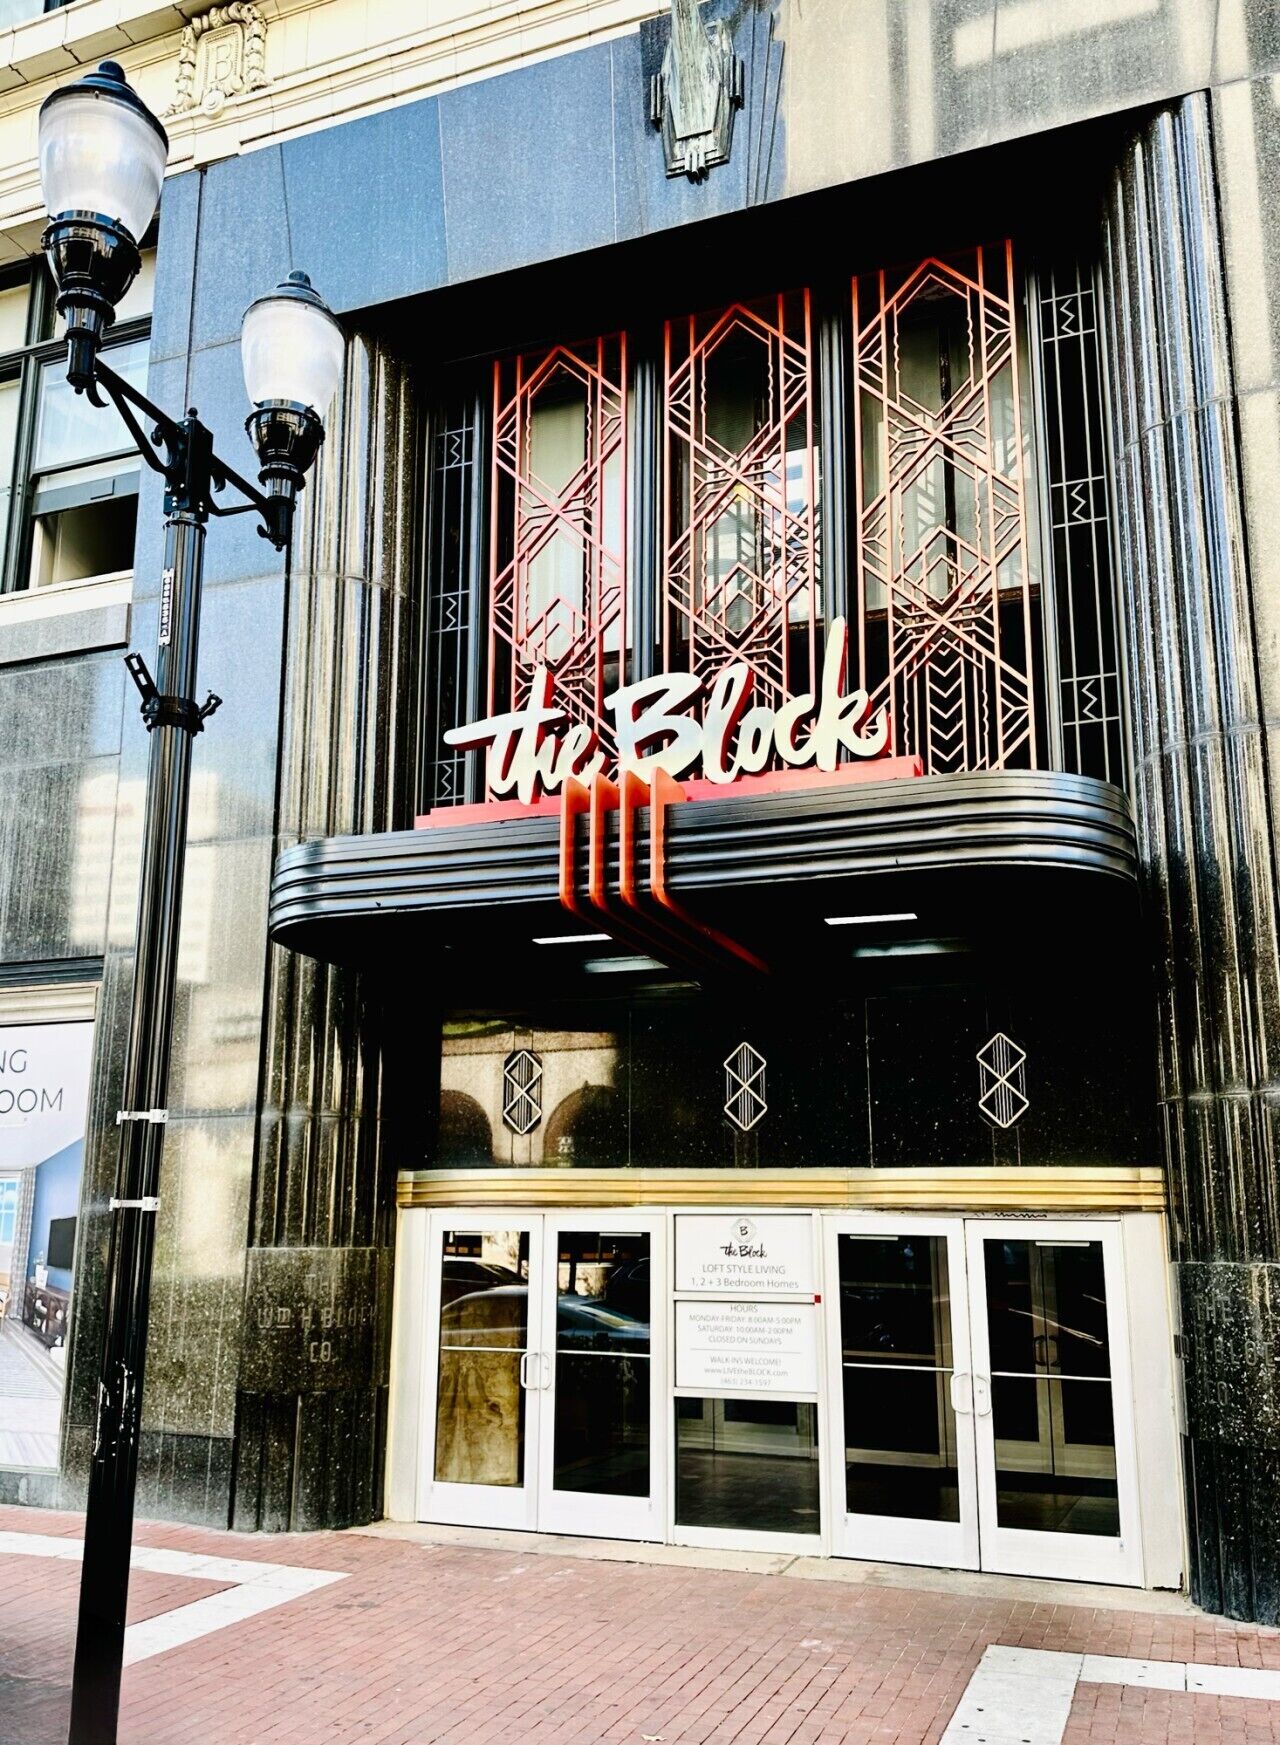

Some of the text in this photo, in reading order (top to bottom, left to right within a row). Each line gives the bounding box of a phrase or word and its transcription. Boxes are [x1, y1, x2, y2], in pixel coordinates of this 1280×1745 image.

[444, 615, 890, 806] the Block
[739, 1225, 749, 1236] B
[719, 1242, 768, 1258] the Block
[702, 1263, 786, 1275] LOFT STYLE LIVING
[700, 1278, 706, 1287] 2
[716, 1278, 722, 1287] 3
[723, 1278, 765, 1288] Bedroom
[767, 1279, 800, 1289] Homes
[730, 1303, 759, 1313] HOURS
[708, 1335, 783, 1346] CLOSED ON SUNDAYS
[703, 1366, 789, 1378] www.LIVEtheBLOCK.com
